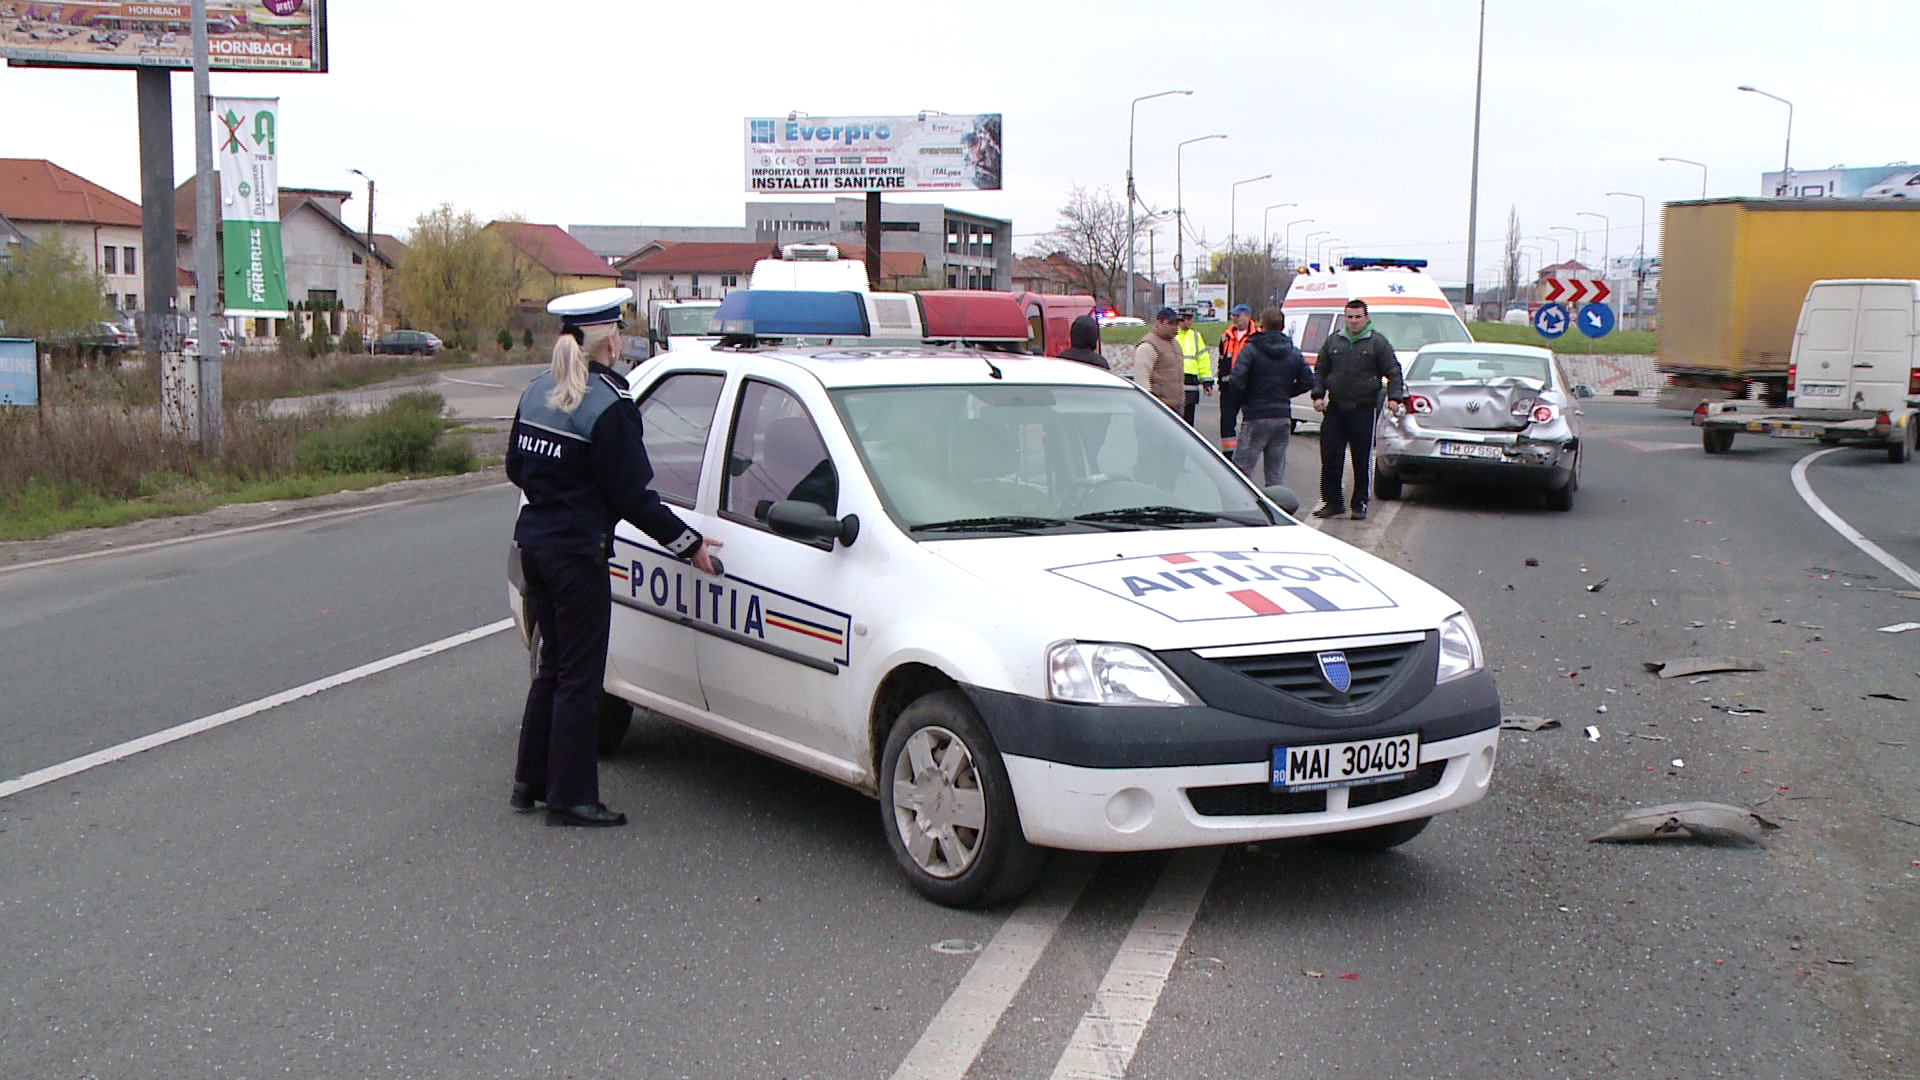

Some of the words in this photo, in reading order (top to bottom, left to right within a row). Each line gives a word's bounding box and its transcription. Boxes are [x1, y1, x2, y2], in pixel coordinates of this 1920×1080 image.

[128, 6, 182, 16] HORNBACH
[208, 40, 293, 56] HORNBACH
[785, 122, 891, 145] Everpro
[255, 153, 267, 161] 700
[751, 168, 810, 176] IMPORTATOR
[815, 167, 866, 175] MATERIALE
[869, 167, 905, 175] PENTRU
[752, 177, 829, 189] INSTALATII
[834, 176, 905, 189] SANITARE
[251, 228, 265, 303] PARBRIZE
[517, 433, 562, 459] POLITIA
[1463, 445, 1476, 454] 07
[632, 560, 765, 639] POLITIA
[1290, 747, 1330, 781] MAI
[1341, 738, 1411, 776] 30403
[1273, 770, 1285, 783] RO
